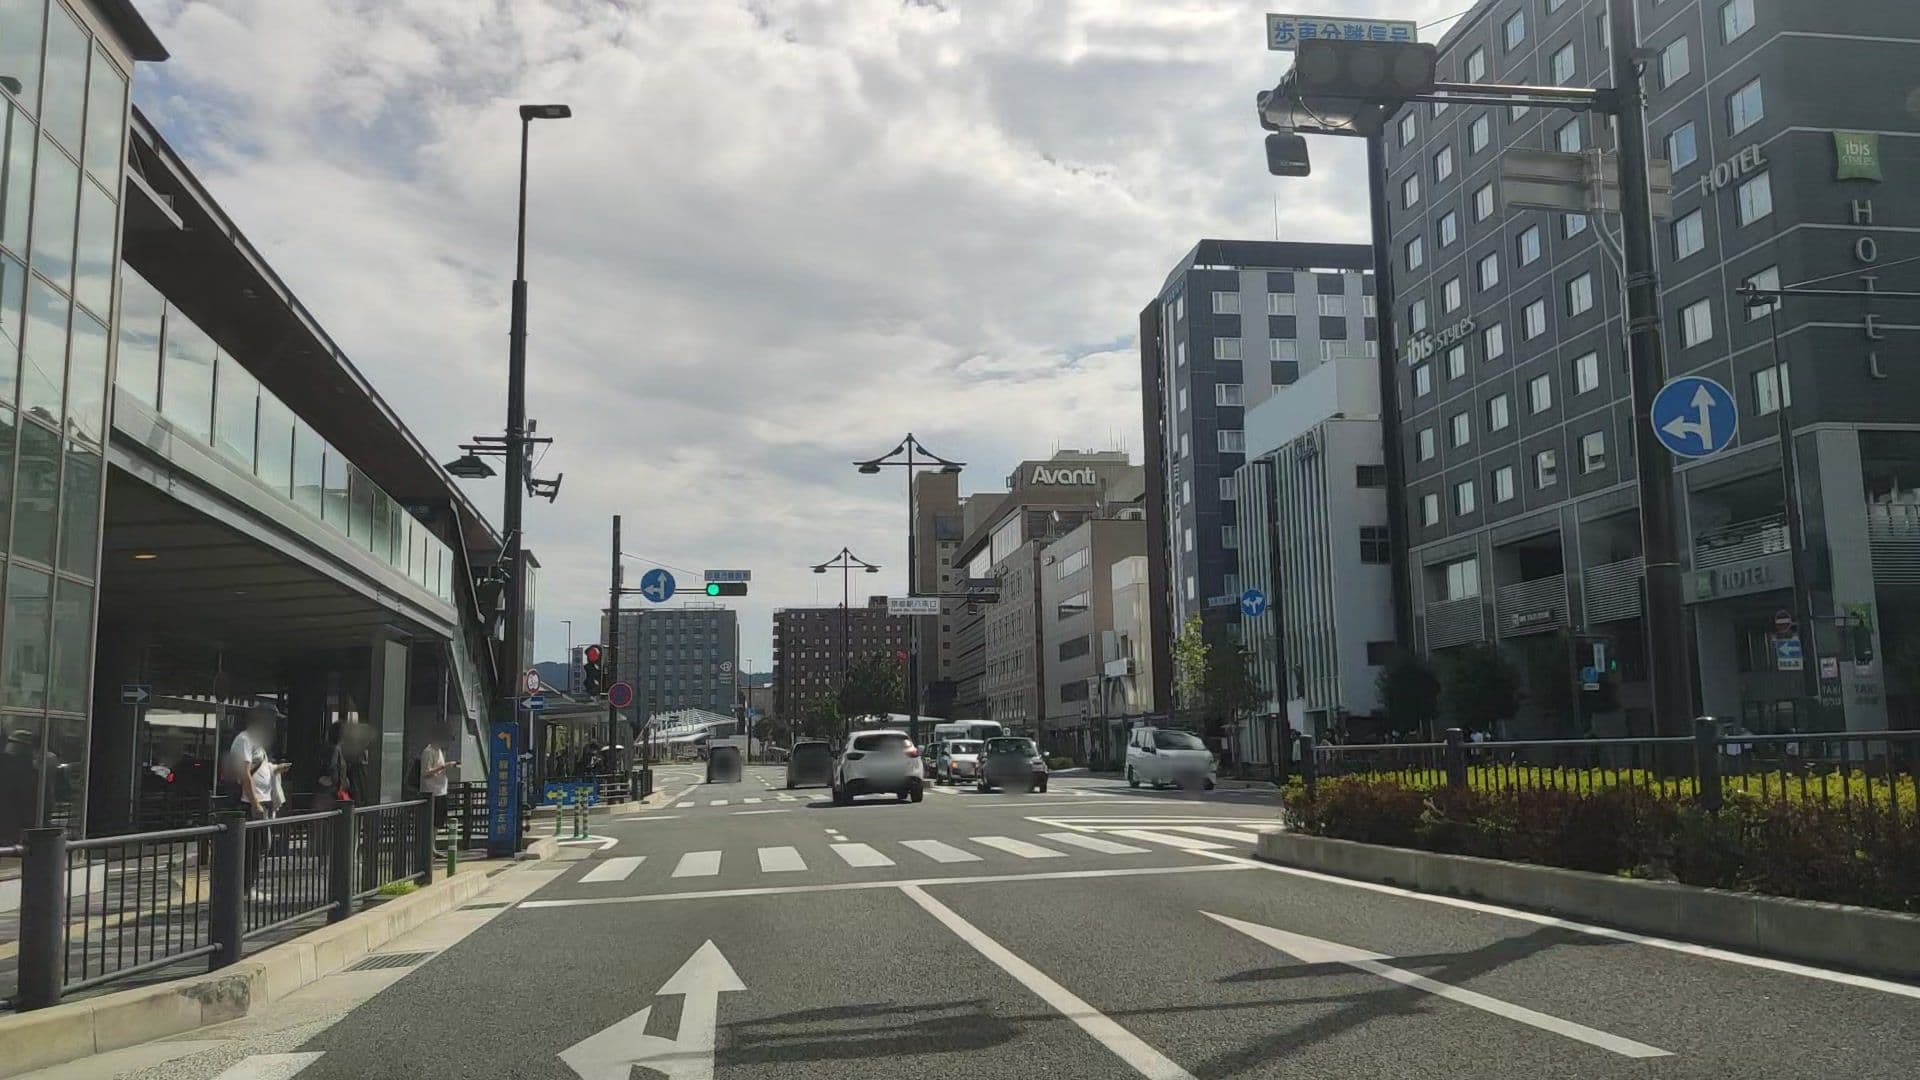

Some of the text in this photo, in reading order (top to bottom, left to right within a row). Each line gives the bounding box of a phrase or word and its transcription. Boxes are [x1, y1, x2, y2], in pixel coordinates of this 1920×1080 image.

[1845, 140, 1870, 156] ibis
[1700, 143, 1768, 197] HOTEL
[1851, 199, 1888, 379] HOTEL
[1407, 331, 1434, 367] ibis
[1031, 465, 1097, 486] Avanti
[1720, 566, 1773, 590] HOTEL
